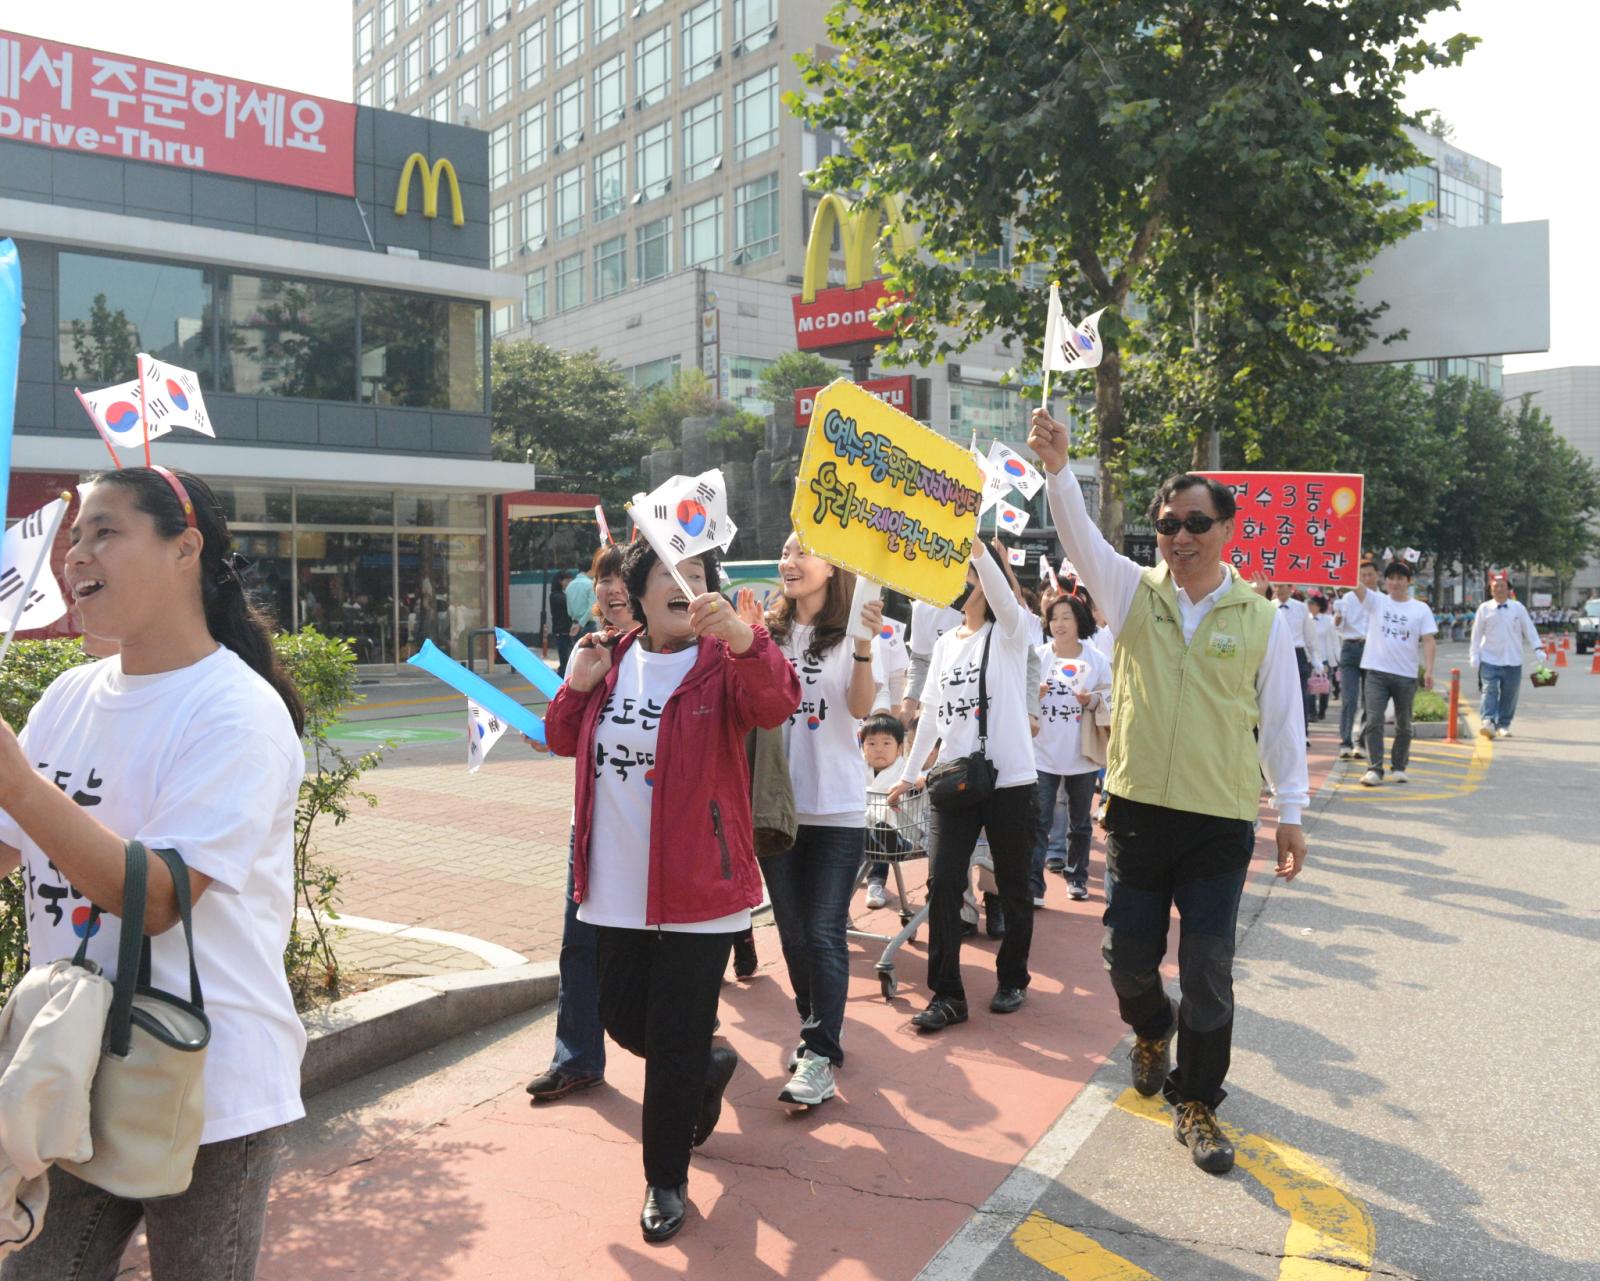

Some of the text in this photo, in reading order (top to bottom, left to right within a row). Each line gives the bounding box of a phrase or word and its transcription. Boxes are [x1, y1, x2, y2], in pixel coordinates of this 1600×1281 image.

[91, 57, 327, 153] 주문하세요
[0, 105, 205, 168] Drive-Thru
[1242, 515, 1333, 547] 화종합
[1231, 546, 1348, 580] 회복지관
